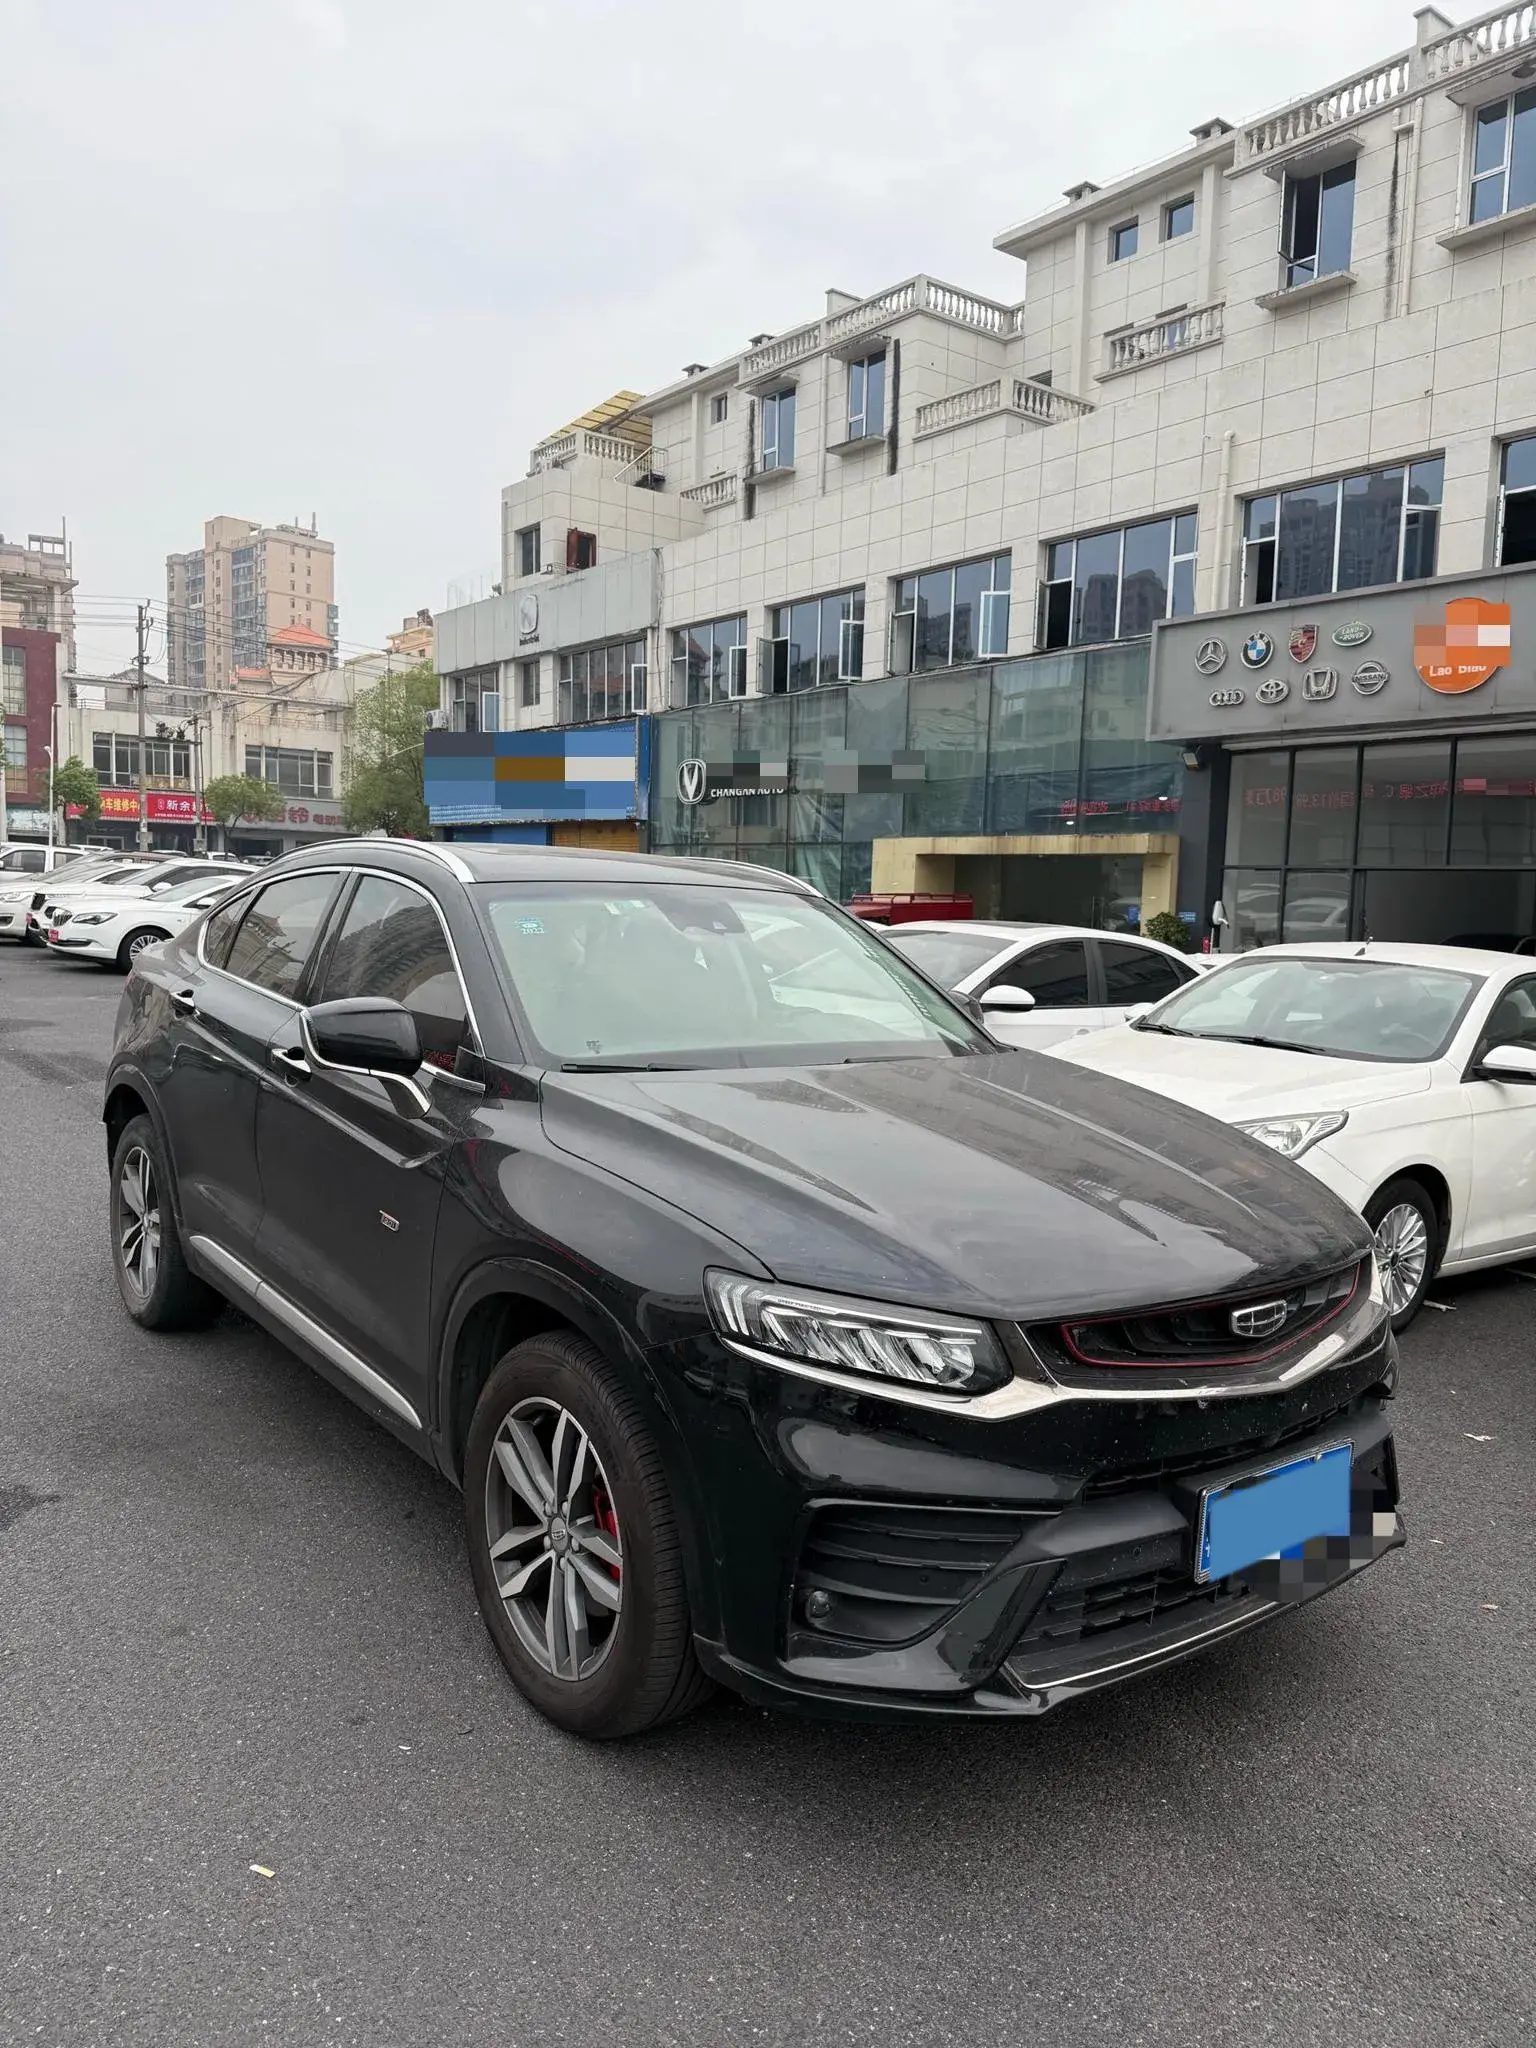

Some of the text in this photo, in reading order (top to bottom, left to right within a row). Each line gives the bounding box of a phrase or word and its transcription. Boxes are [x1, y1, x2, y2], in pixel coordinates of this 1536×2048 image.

[1429, 665, 1452, 677] Lao
[1354, 674, 1384, 682] NISSAN
[710, 788, 755, 798] CHANGAN
